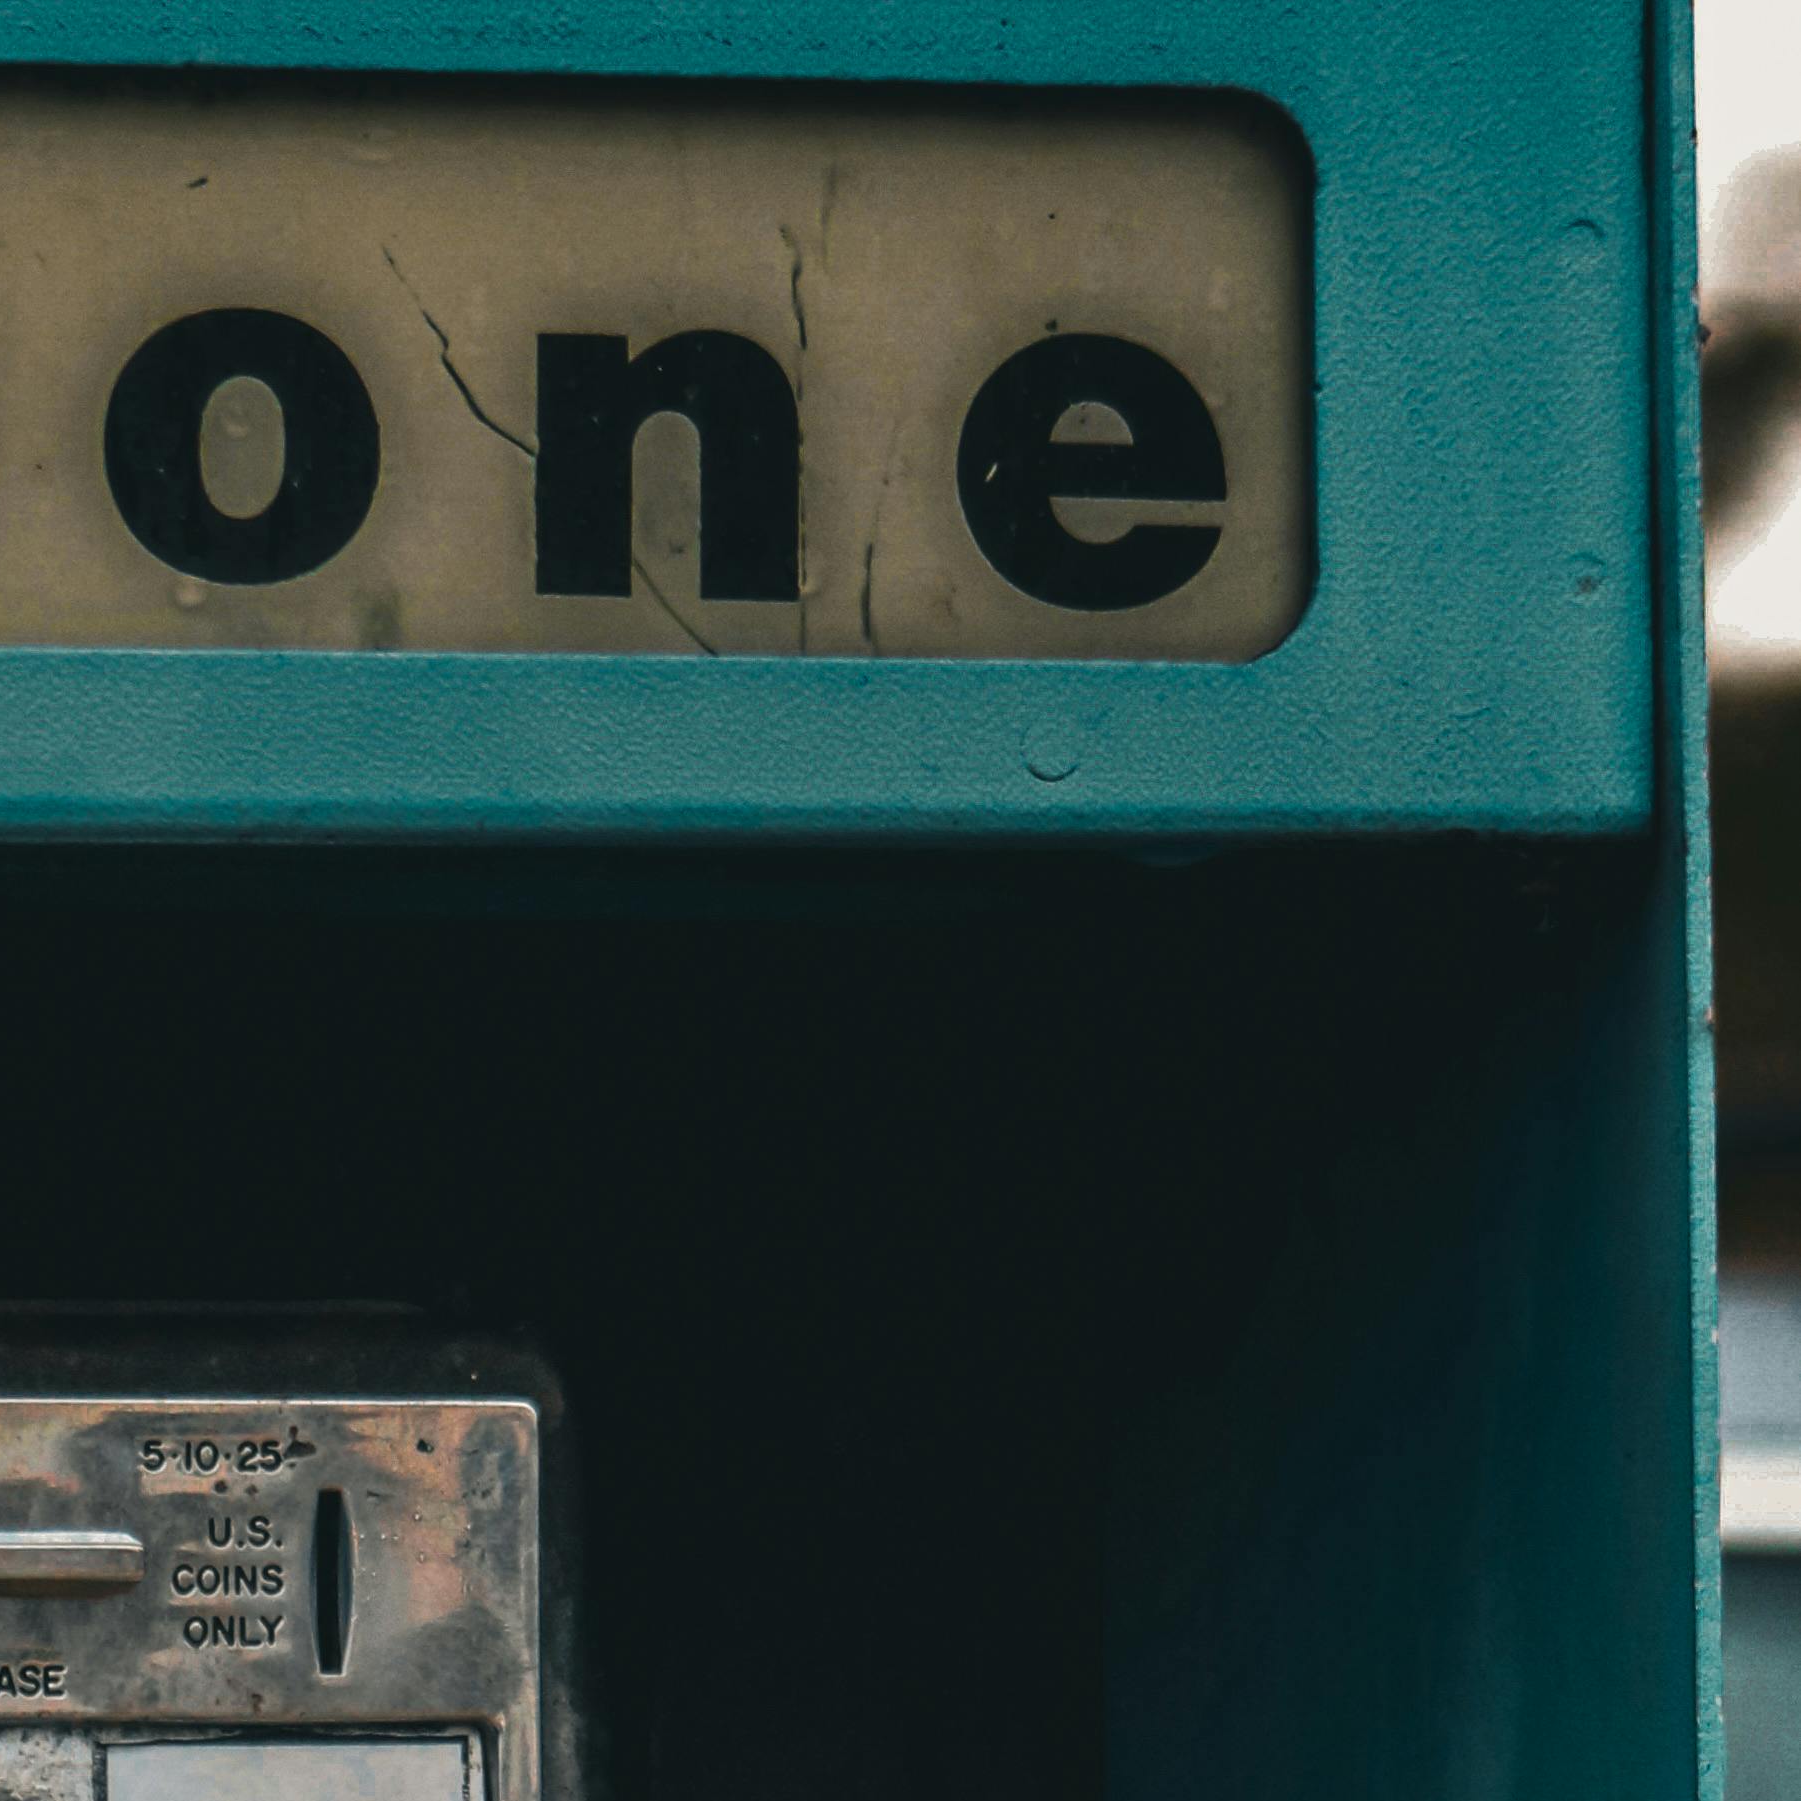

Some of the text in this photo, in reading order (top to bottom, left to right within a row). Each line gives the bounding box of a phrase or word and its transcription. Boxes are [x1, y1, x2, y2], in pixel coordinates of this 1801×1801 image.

[208, 1515, 283, 1548] U.S.
[172, 1563, 285, 1597] COINS
[183, 1615, 284, 1648] ONLY
